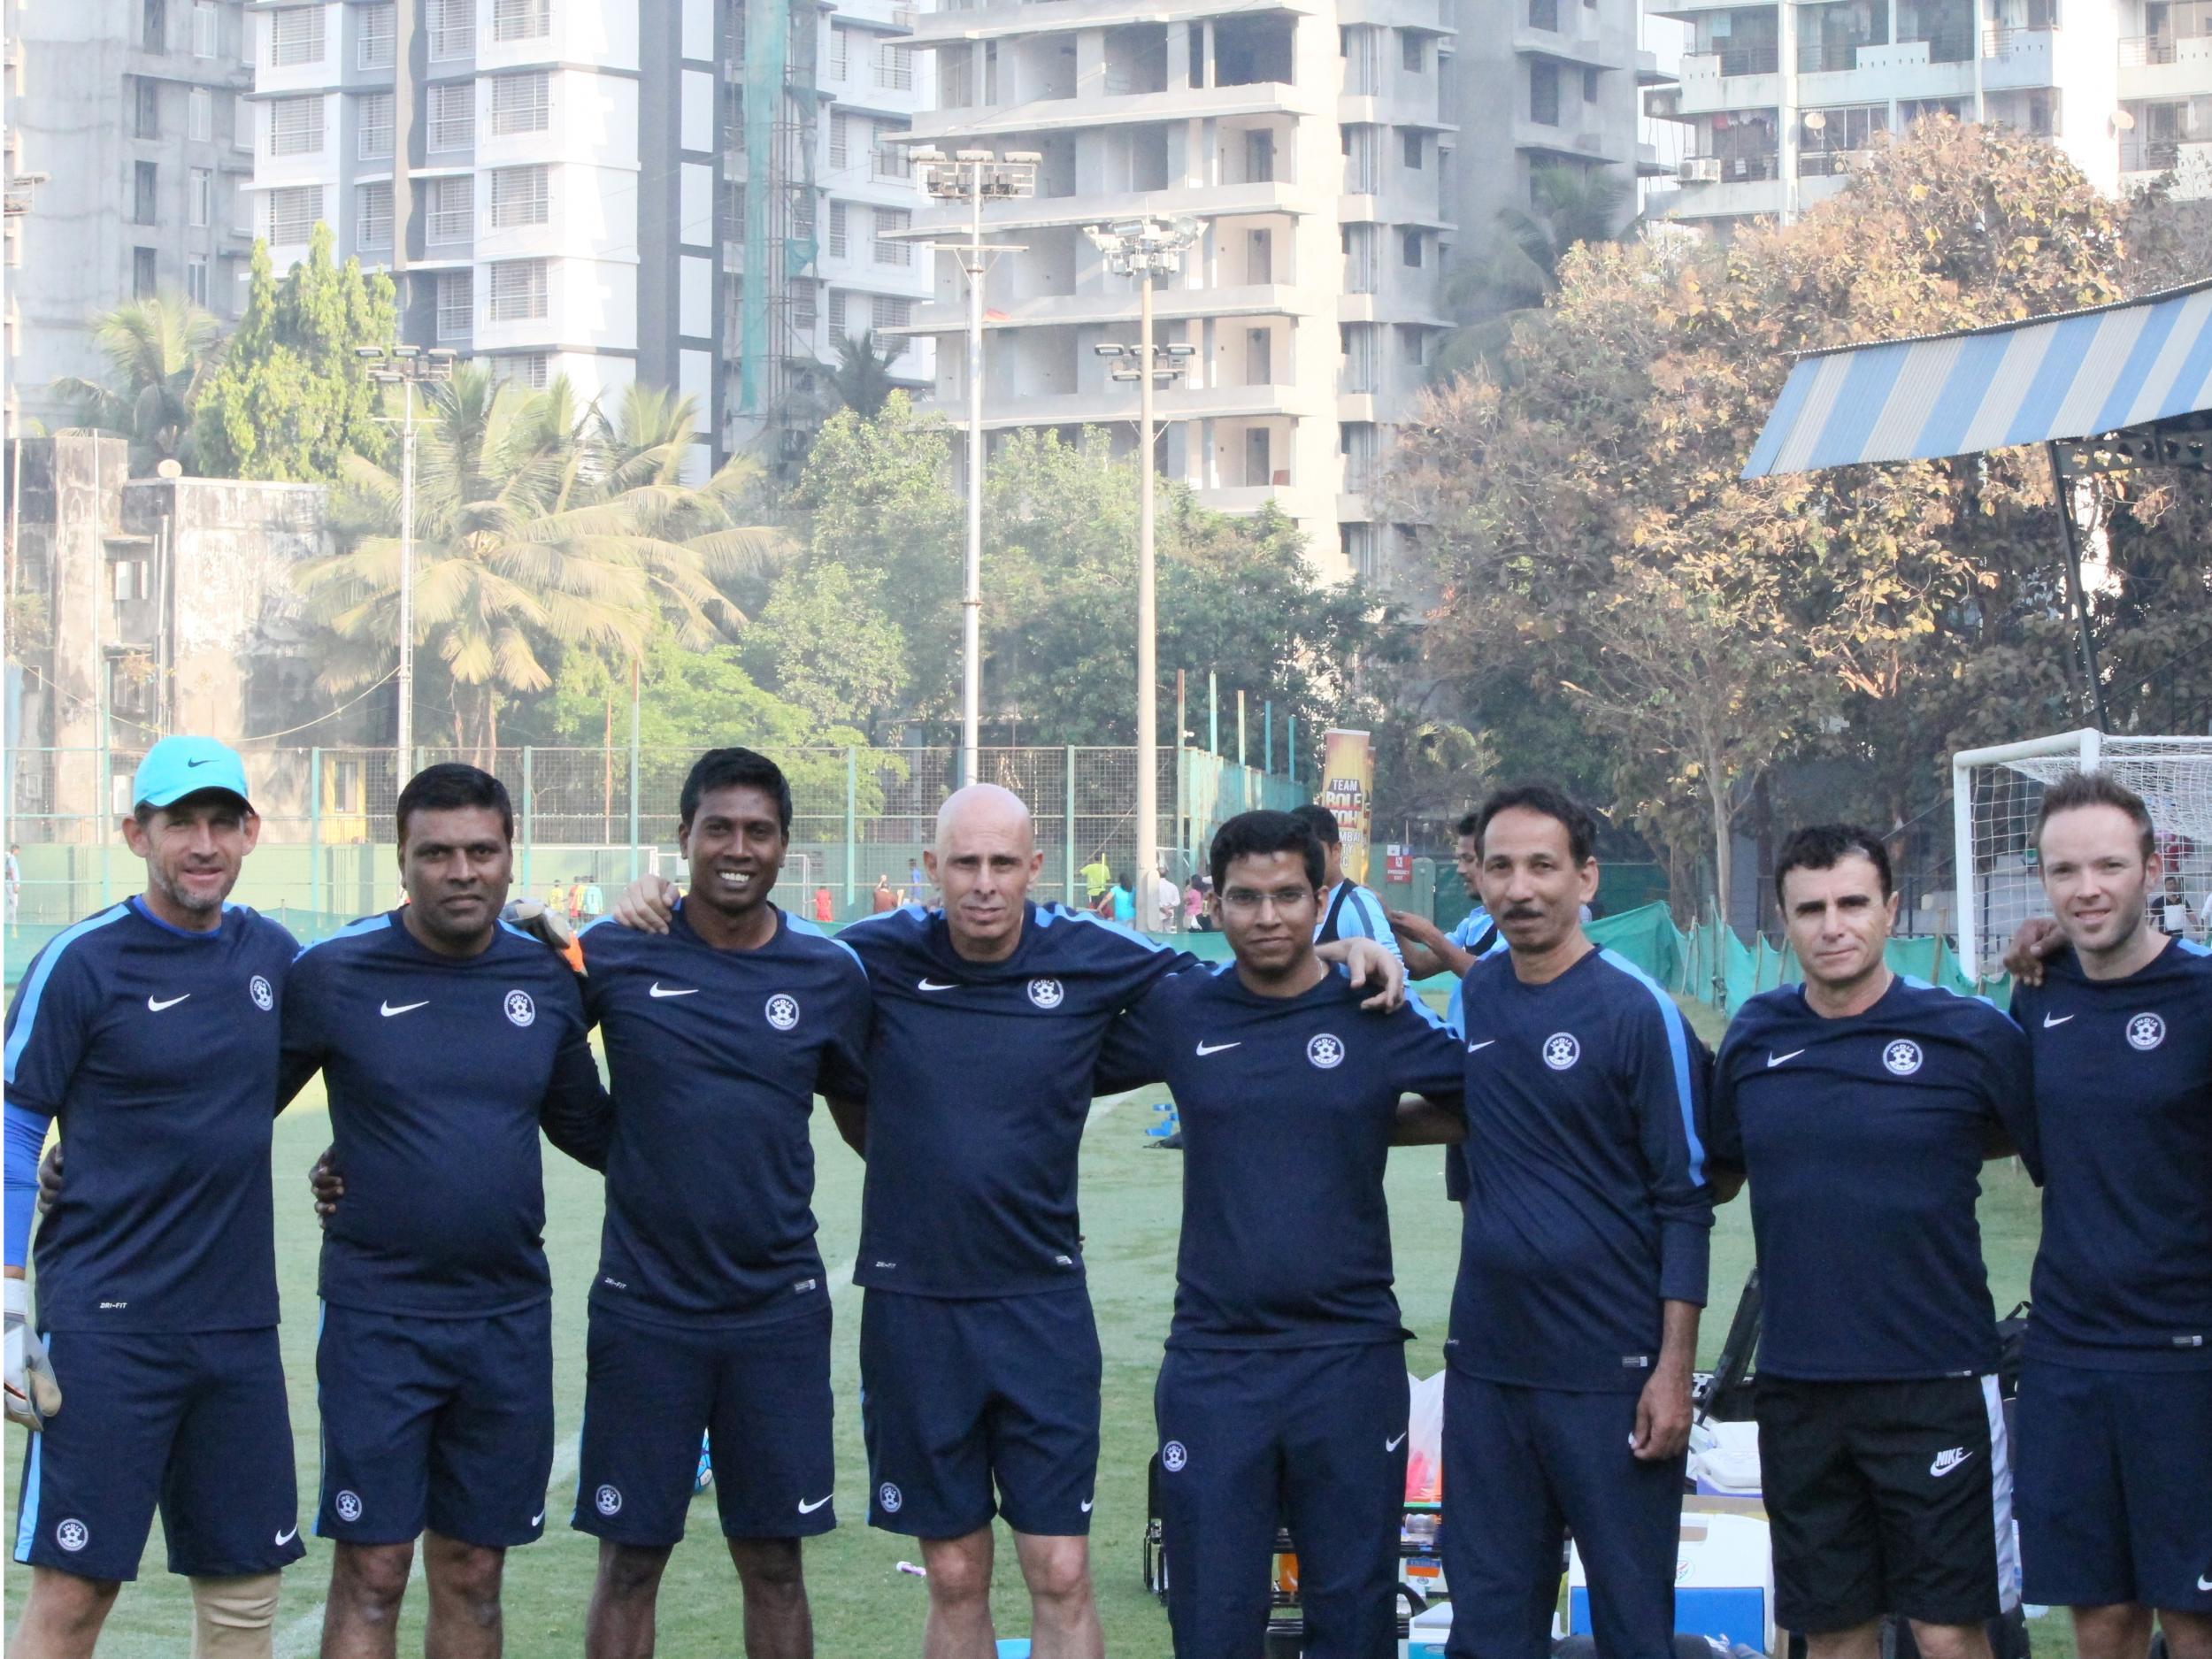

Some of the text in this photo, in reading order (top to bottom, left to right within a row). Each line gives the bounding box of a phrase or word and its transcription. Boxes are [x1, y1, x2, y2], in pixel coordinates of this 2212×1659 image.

[1333, 780, 1357, 791] TEAM
[1339, 832, 1361, 842] MBAI
[1340, 856, 1348, 867] C
[1033, 979, 1055, 989] INDIA
[510, 995, 527, 1005] INDIA
[772, 999, 794, 1010] INDIA
[2134, 1018, 2158, 1027] INDIA
[1313, 1038, 1336, 1048] INDIA
[1550, 1038, 1572, 1048] INDIA
[1890, 1044, 1914, 1054] INDIA
[1936, 1447, 1963, 1466] NIKE
[63, 1523, 82, 1532] INDIA
